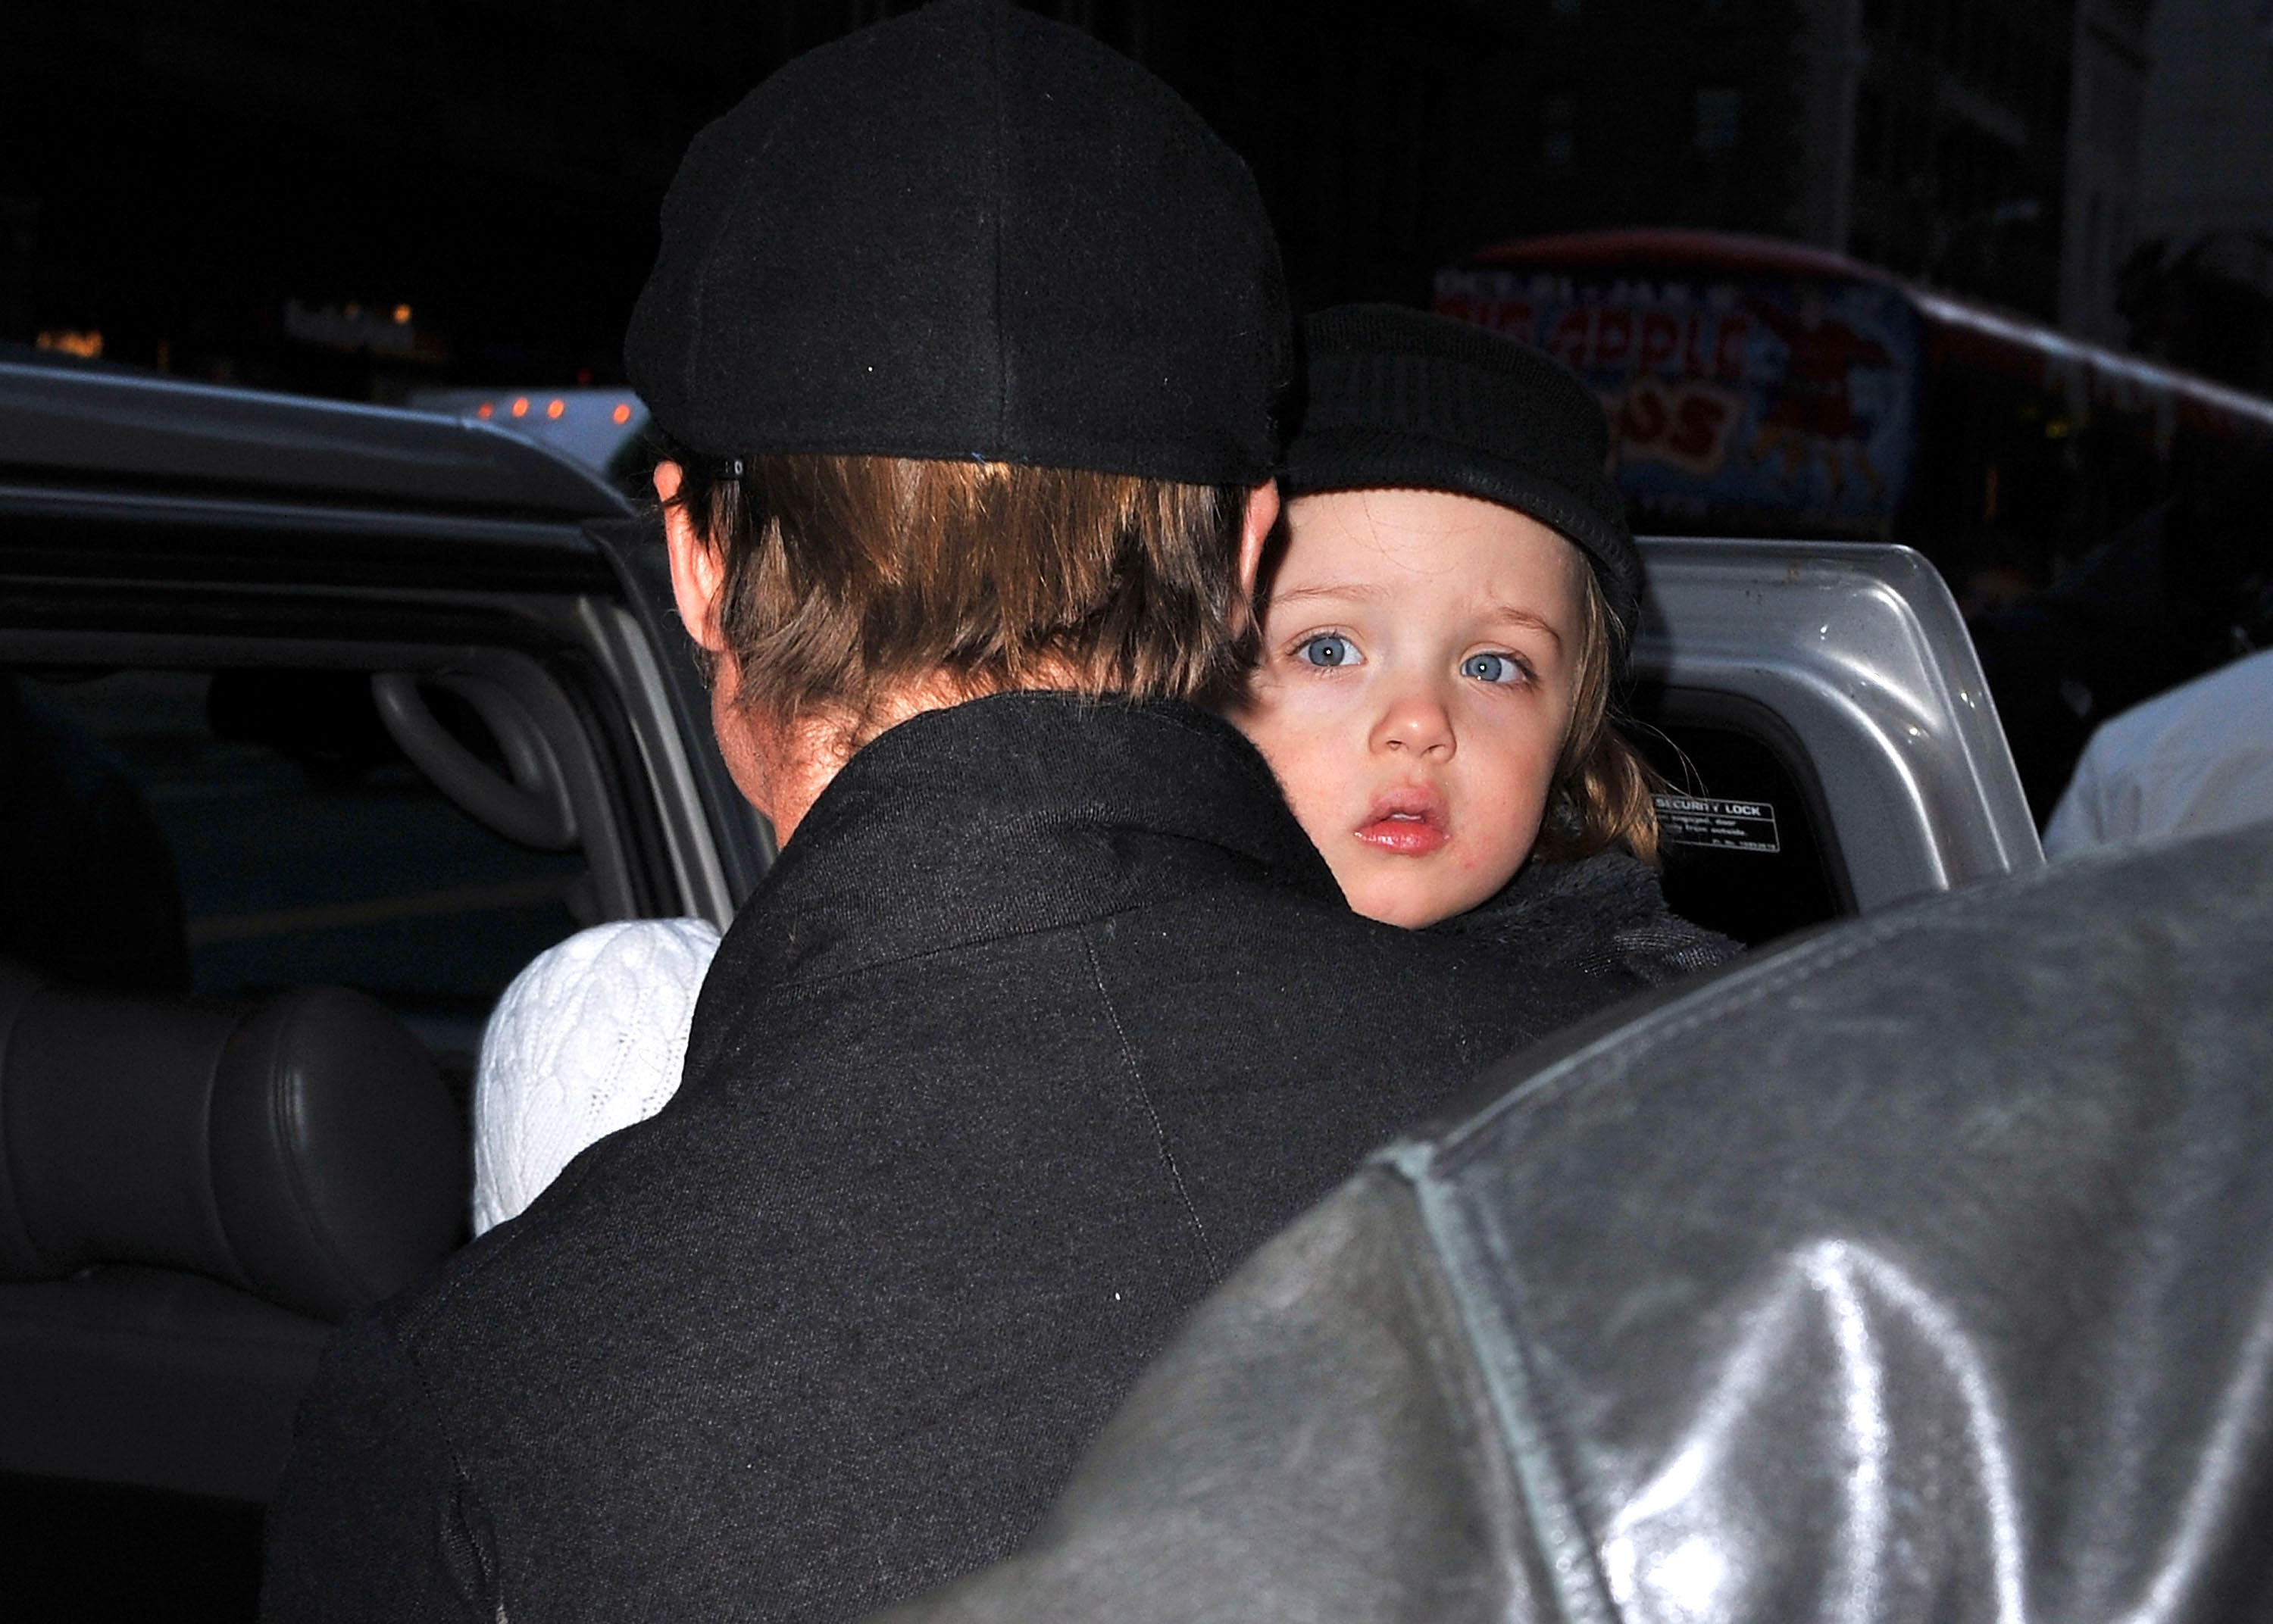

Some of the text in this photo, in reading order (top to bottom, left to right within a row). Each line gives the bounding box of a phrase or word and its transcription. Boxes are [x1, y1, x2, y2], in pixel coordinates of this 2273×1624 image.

[1611, 389, 1727, 457] US
[1655, 798, 1762, 817] SECURITY LOCK
